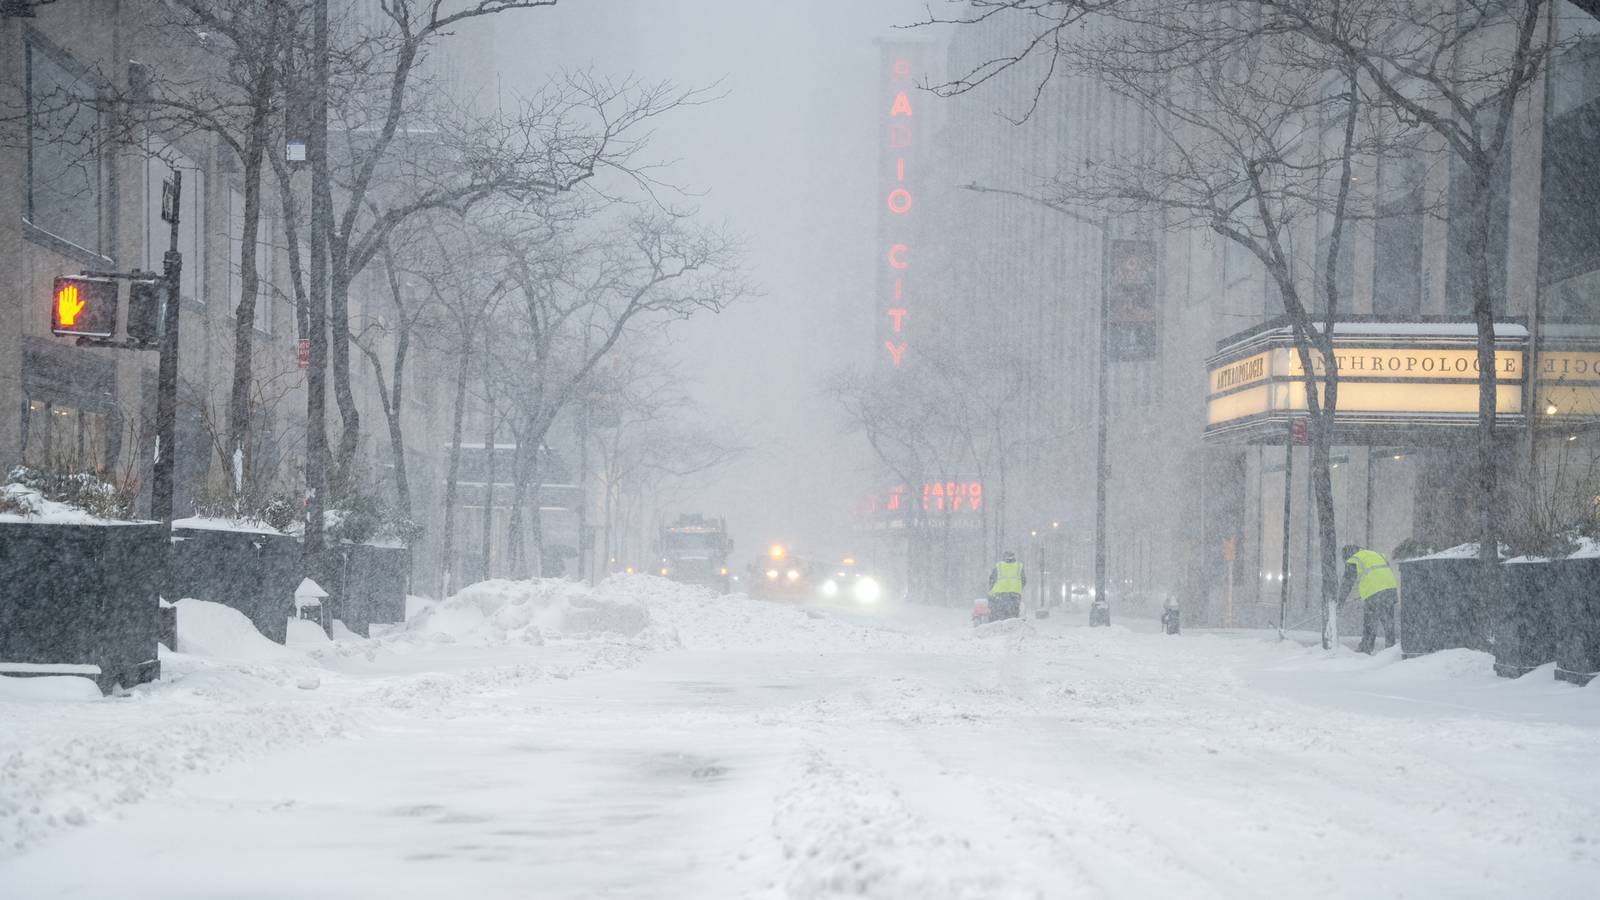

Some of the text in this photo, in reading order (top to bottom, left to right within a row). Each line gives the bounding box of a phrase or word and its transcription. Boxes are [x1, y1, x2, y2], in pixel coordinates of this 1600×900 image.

[885, 58, 912, 365] RADIO CITY
[1298, 356, 1516, 372] NTHROPOLOE
